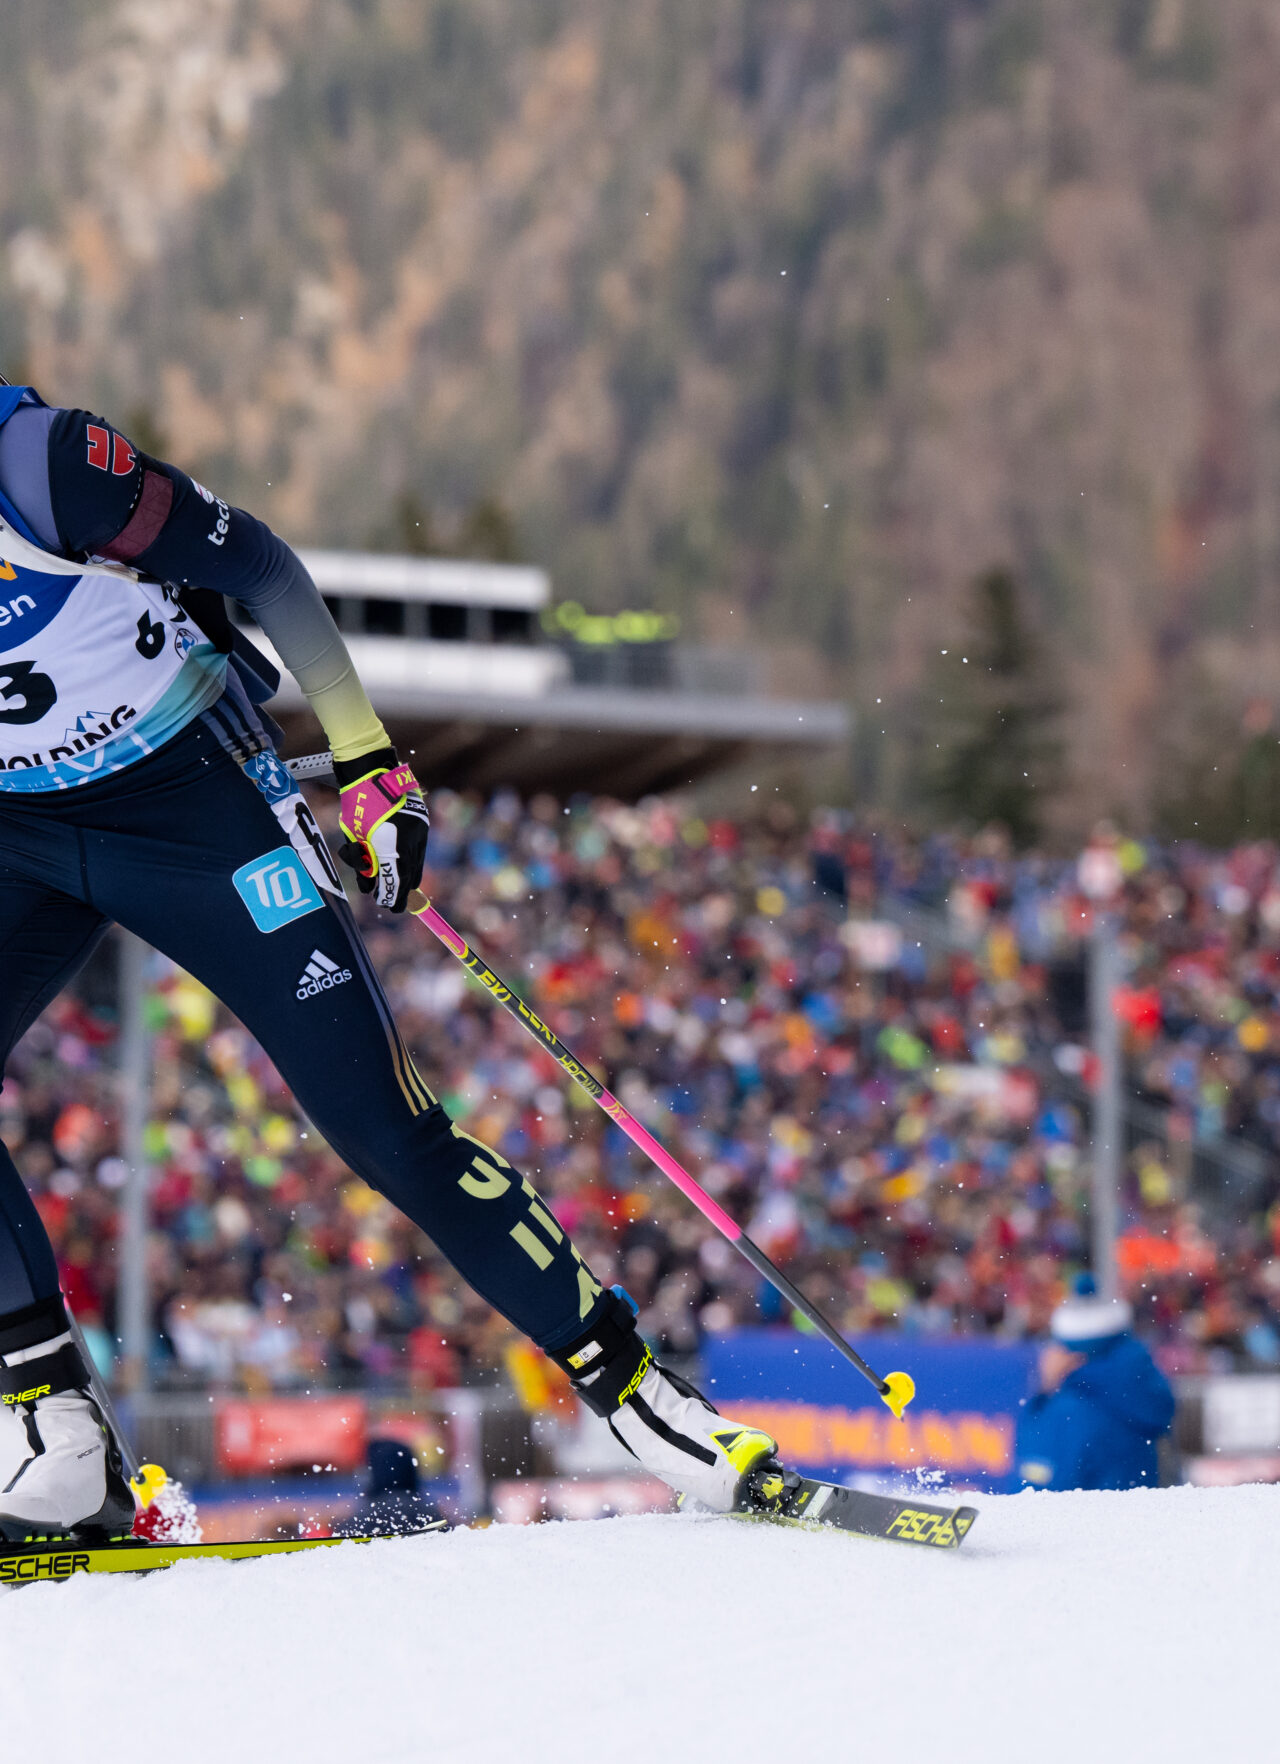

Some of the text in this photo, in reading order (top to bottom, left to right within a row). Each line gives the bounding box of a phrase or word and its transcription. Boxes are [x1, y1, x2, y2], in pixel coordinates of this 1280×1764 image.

[352, 792, 368, 841] LEKI
[245, 860, 313, 909] TQ
[296, 968, 353, 1001] adidas
